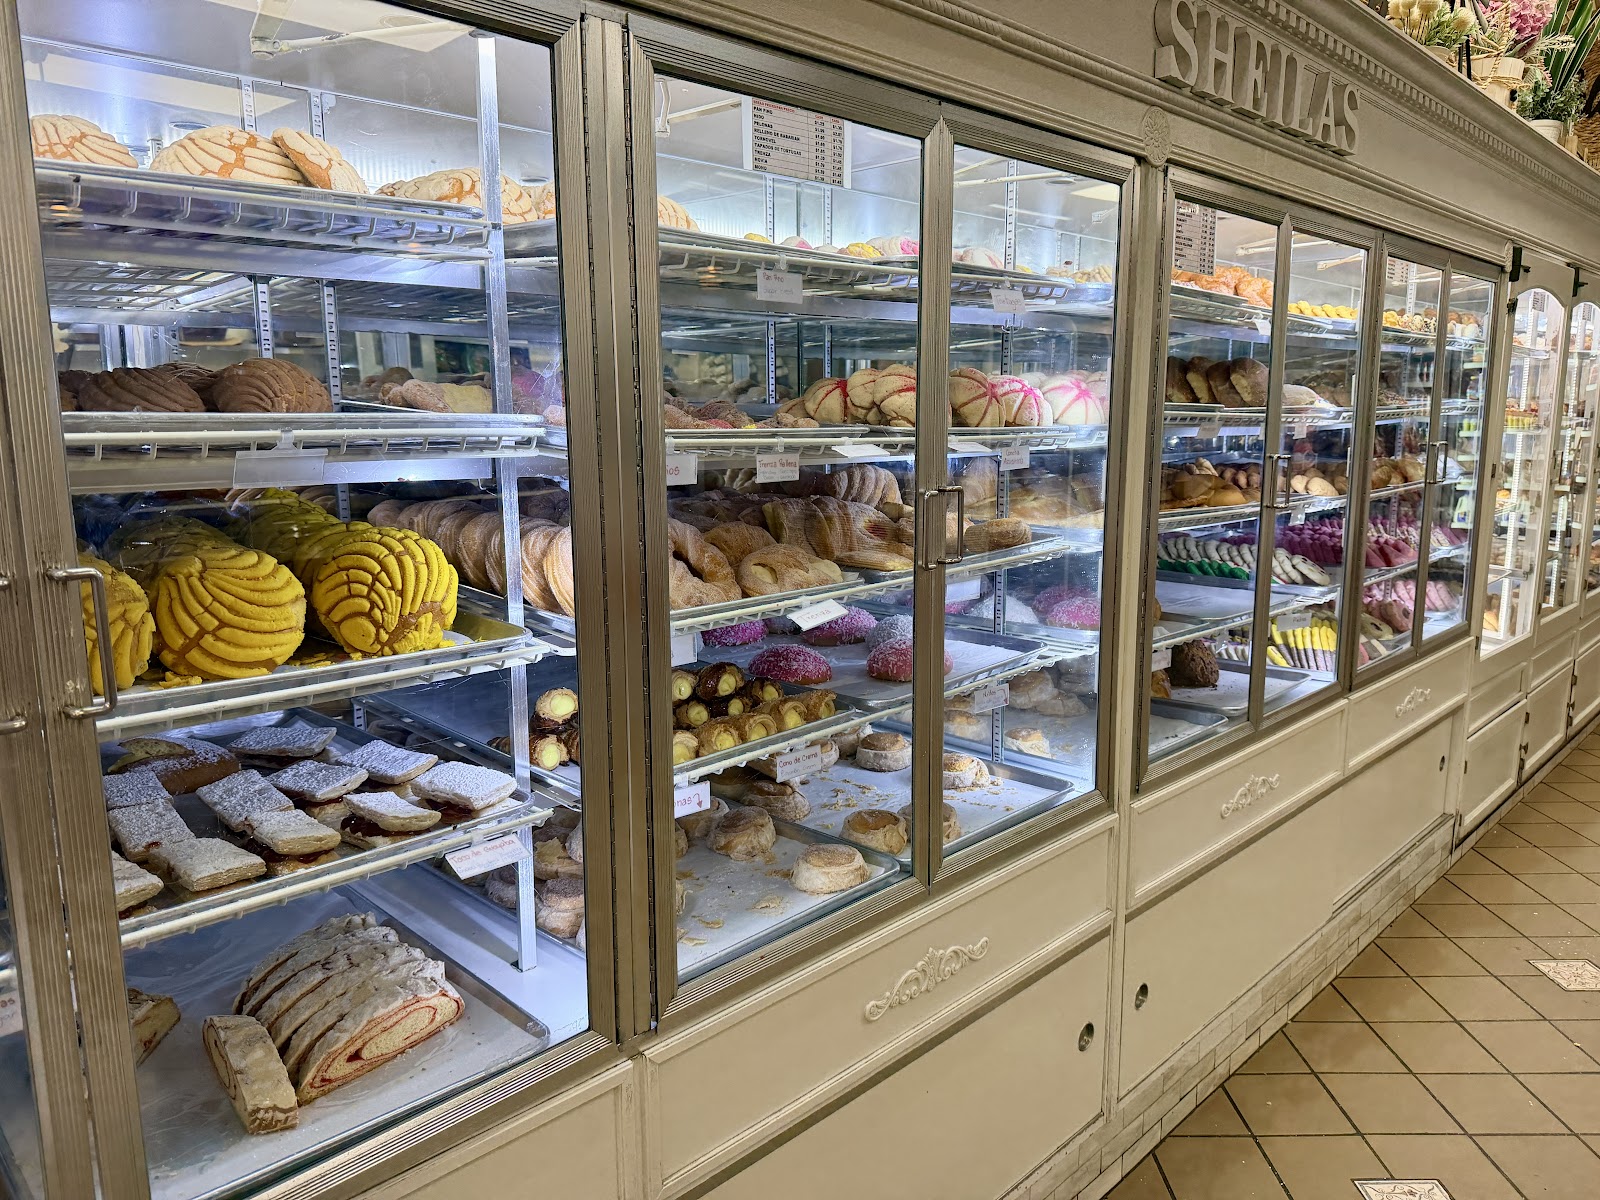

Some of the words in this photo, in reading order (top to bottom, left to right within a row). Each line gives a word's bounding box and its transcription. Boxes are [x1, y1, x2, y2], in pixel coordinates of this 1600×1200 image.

[1154, 0, 1359, 156] SHEILAS
[780, 148, 802, 156] TORTUGAS
[758, 460, 778, 468] Trenza
[778, 760, 792, 768] Cono
[794, 756, 800, 764] de
[802, 752, 818, 762] Crema
